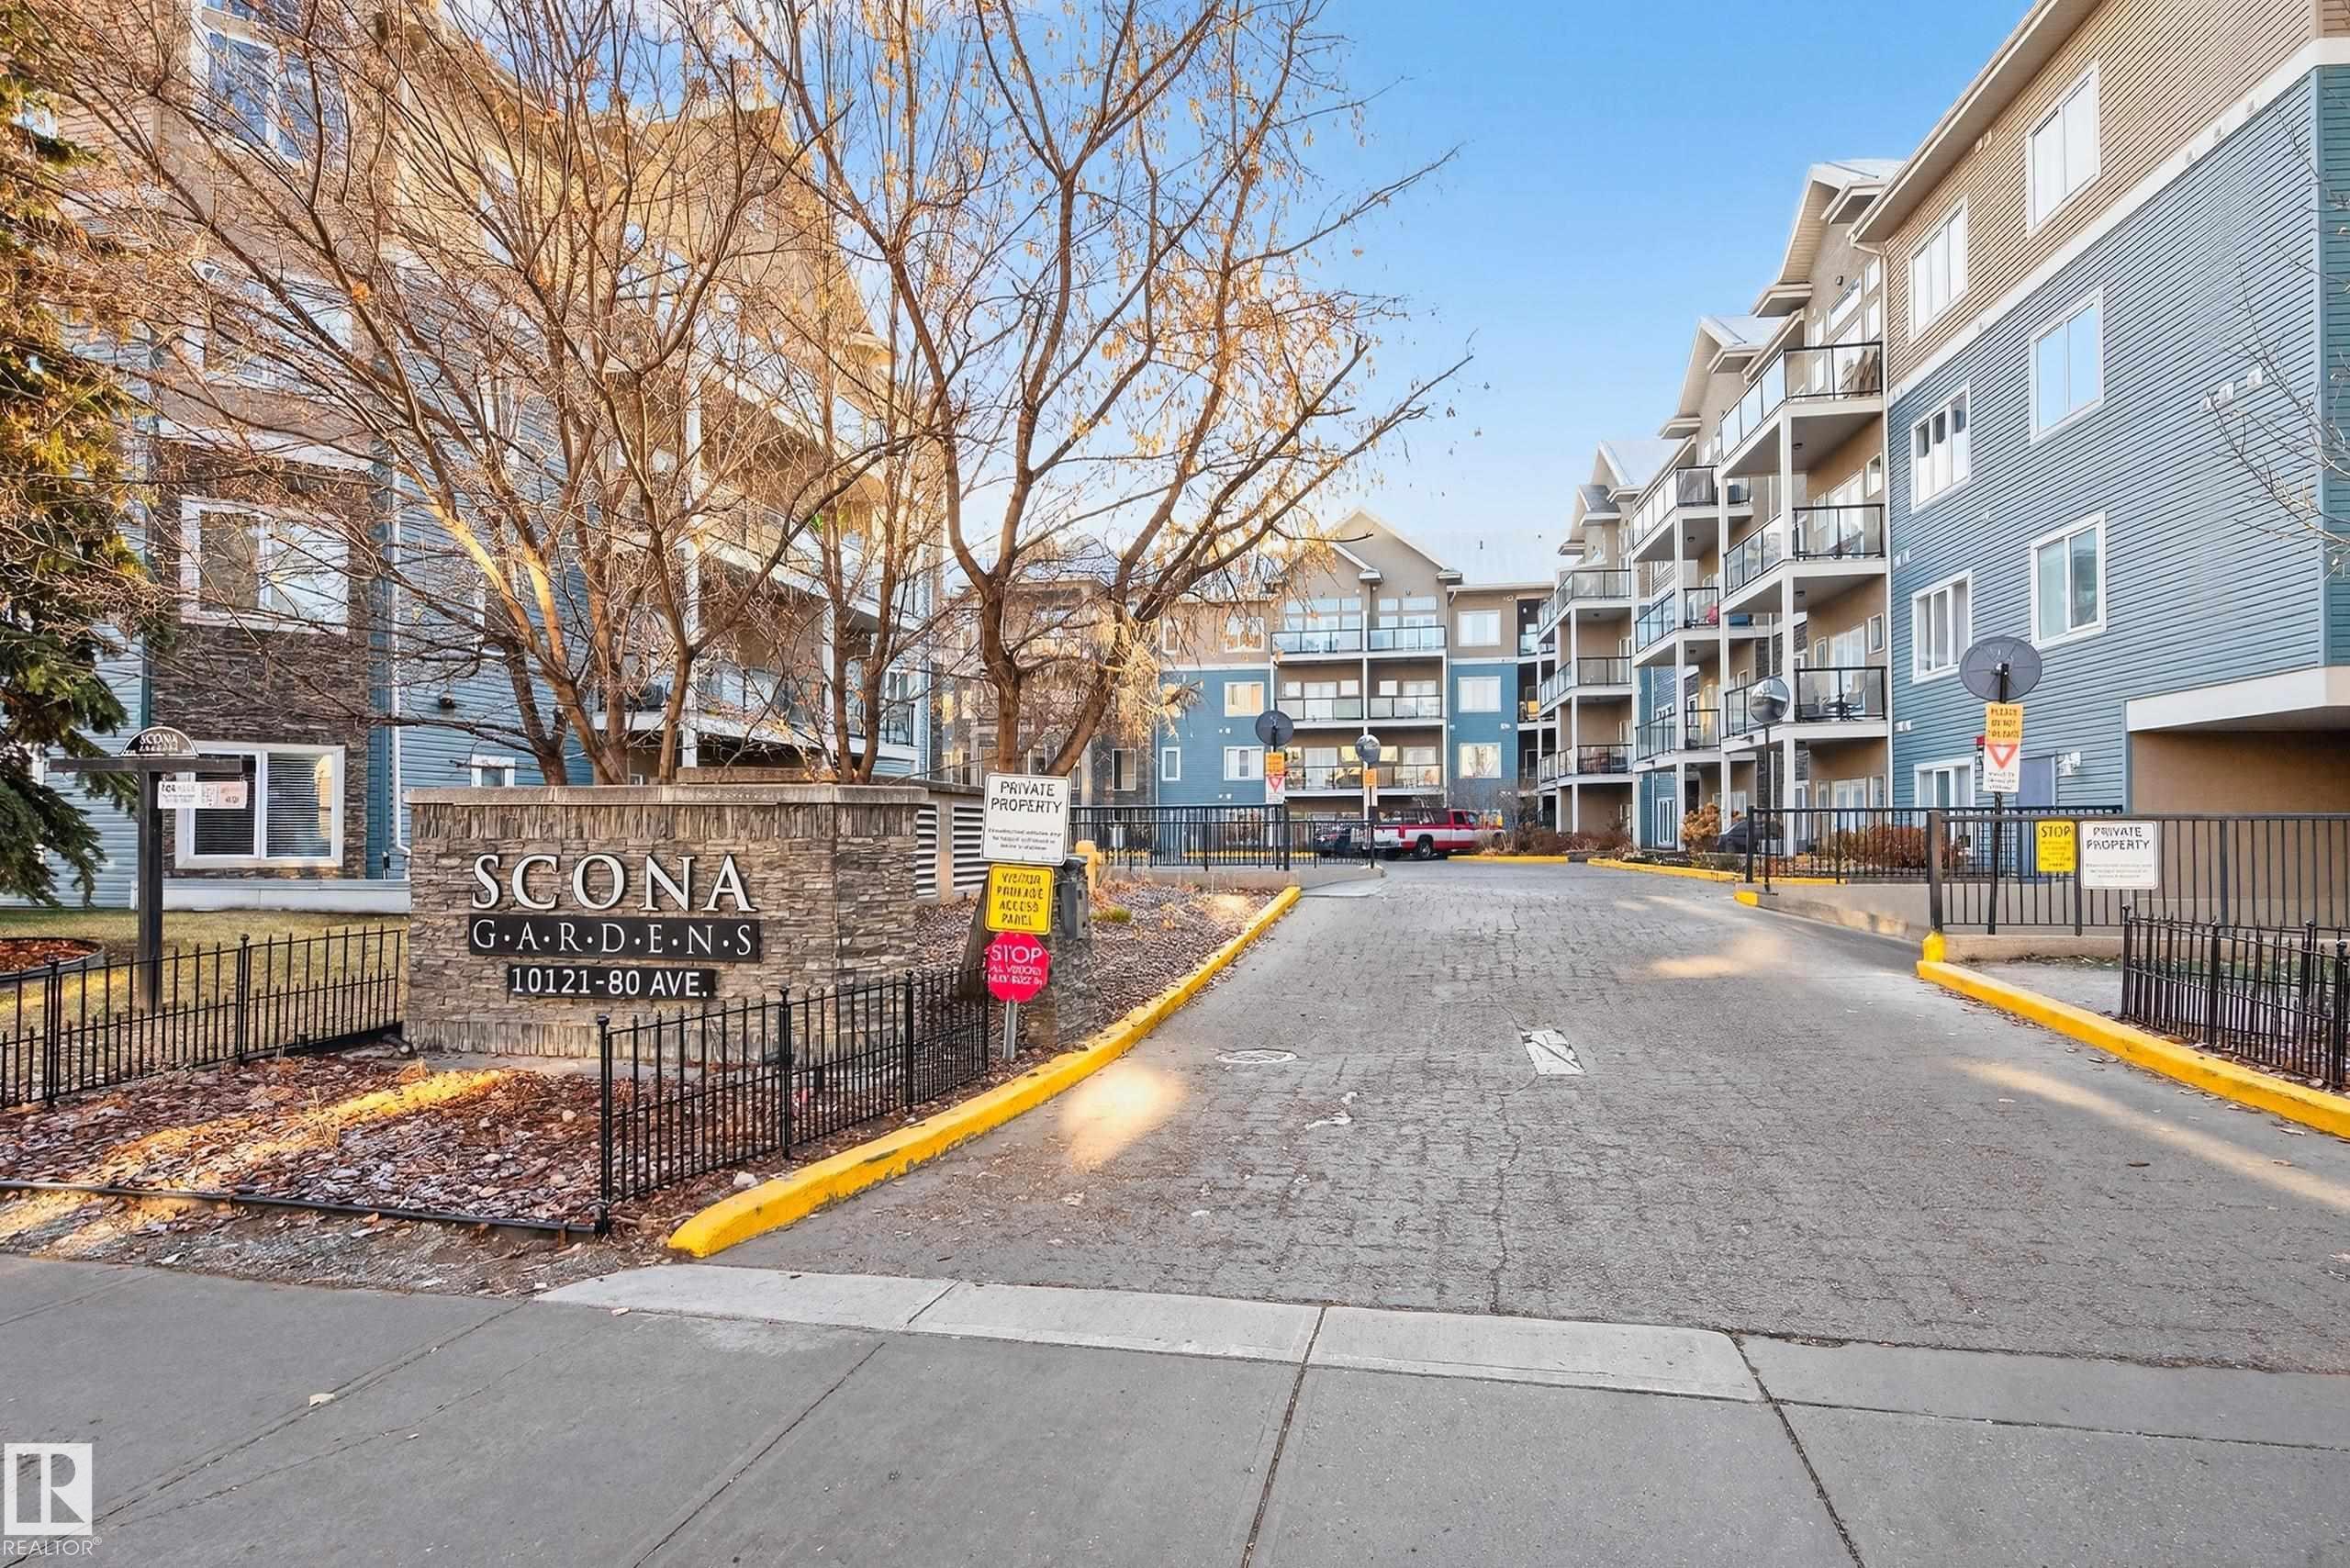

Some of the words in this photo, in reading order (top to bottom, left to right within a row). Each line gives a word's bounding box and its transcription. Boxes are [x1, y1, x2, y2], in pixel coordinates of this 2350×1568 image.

[1000, 780, 1056, 797] PRIVATE
[990, 797, 1063, 814] PROPERTY
[2041, 825, 2071, 838] STOP
[2092, 826, 2143, 837] PRIVATE
[2086, 838, 2150, 850] PROPERTY
[470, 853, 758, 913] SCONA
[990, 944, 1044, 964] STOP
[511, 967, 641, 996] 10121-80
[648, 969, 709, 998] AVE.
